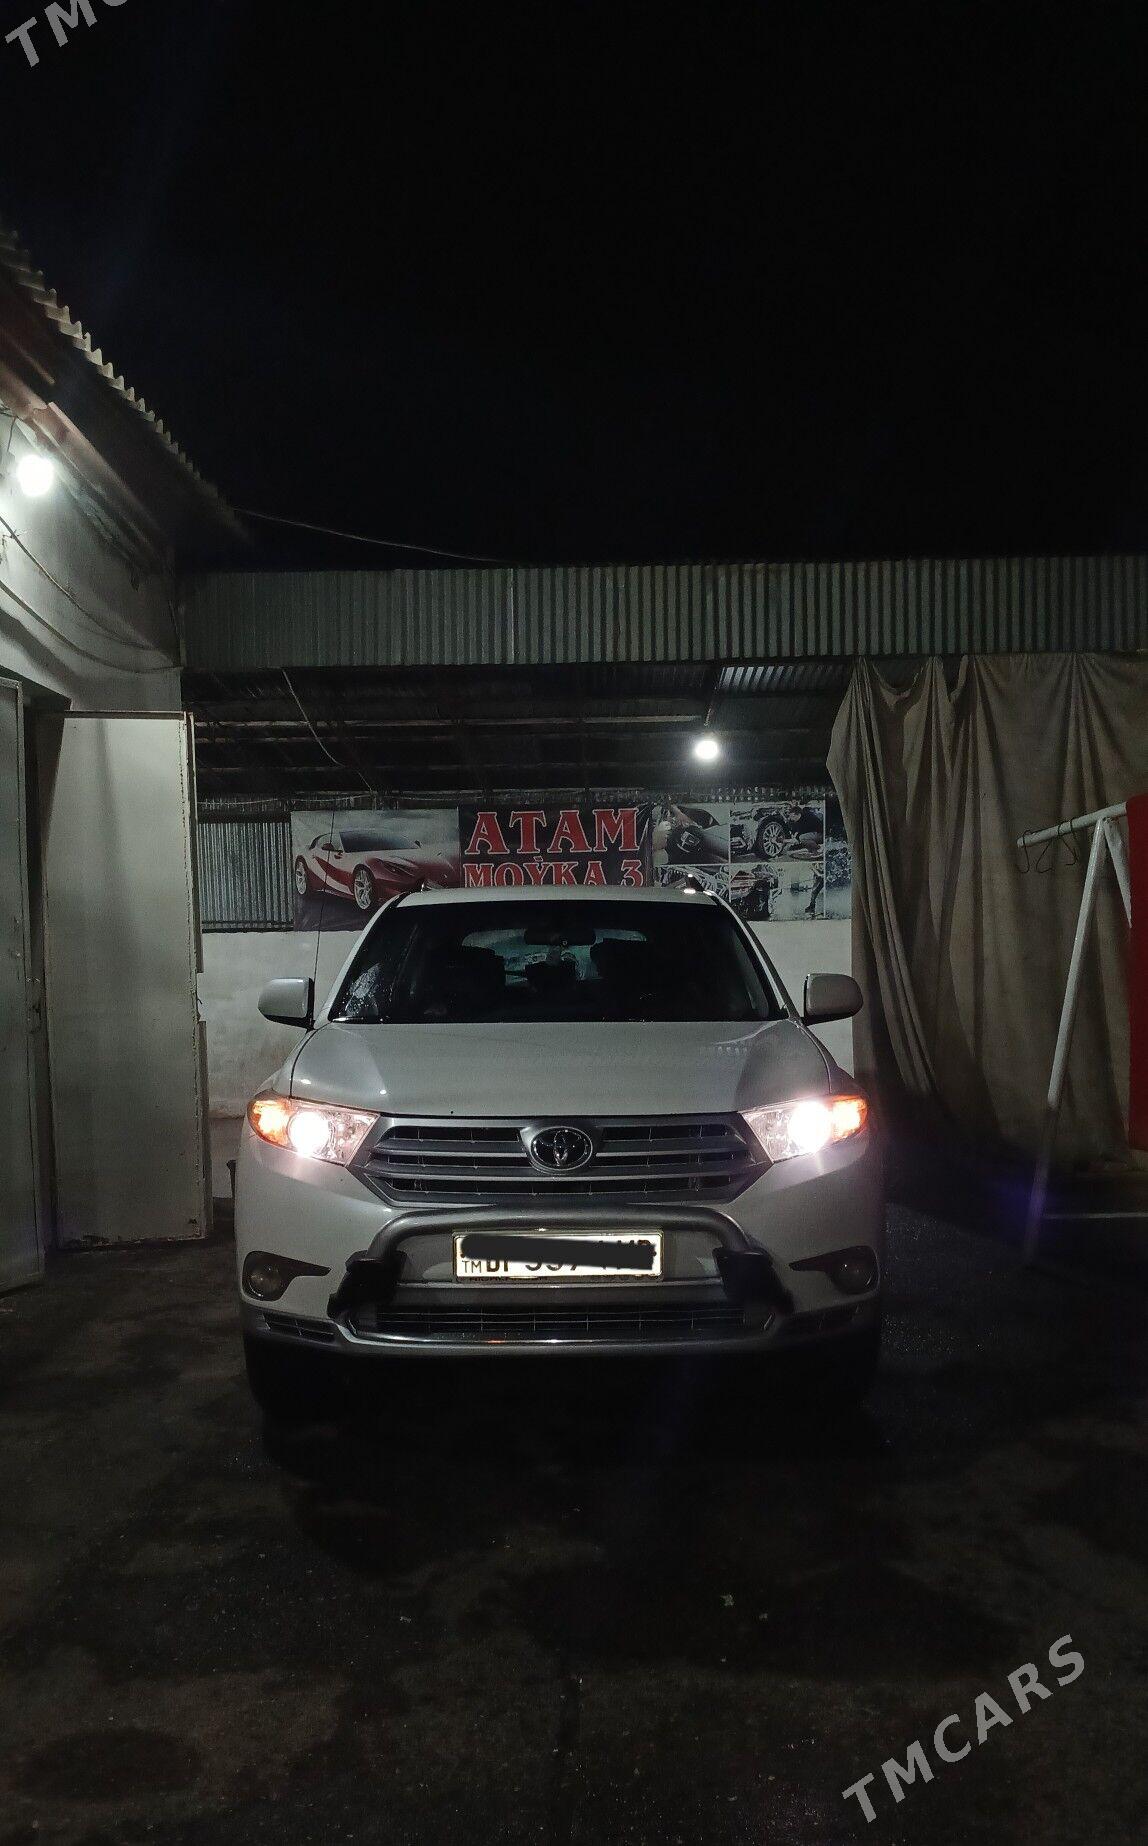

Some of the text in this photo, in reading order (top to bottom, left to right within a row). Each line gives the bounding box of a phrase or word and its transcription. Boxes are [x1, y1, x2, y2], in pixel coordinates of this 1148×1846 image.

[465, 808, 639, 855] ATAM
[621, 860, 643, 887] 3
[461, 1260, 482, 1274] TM
